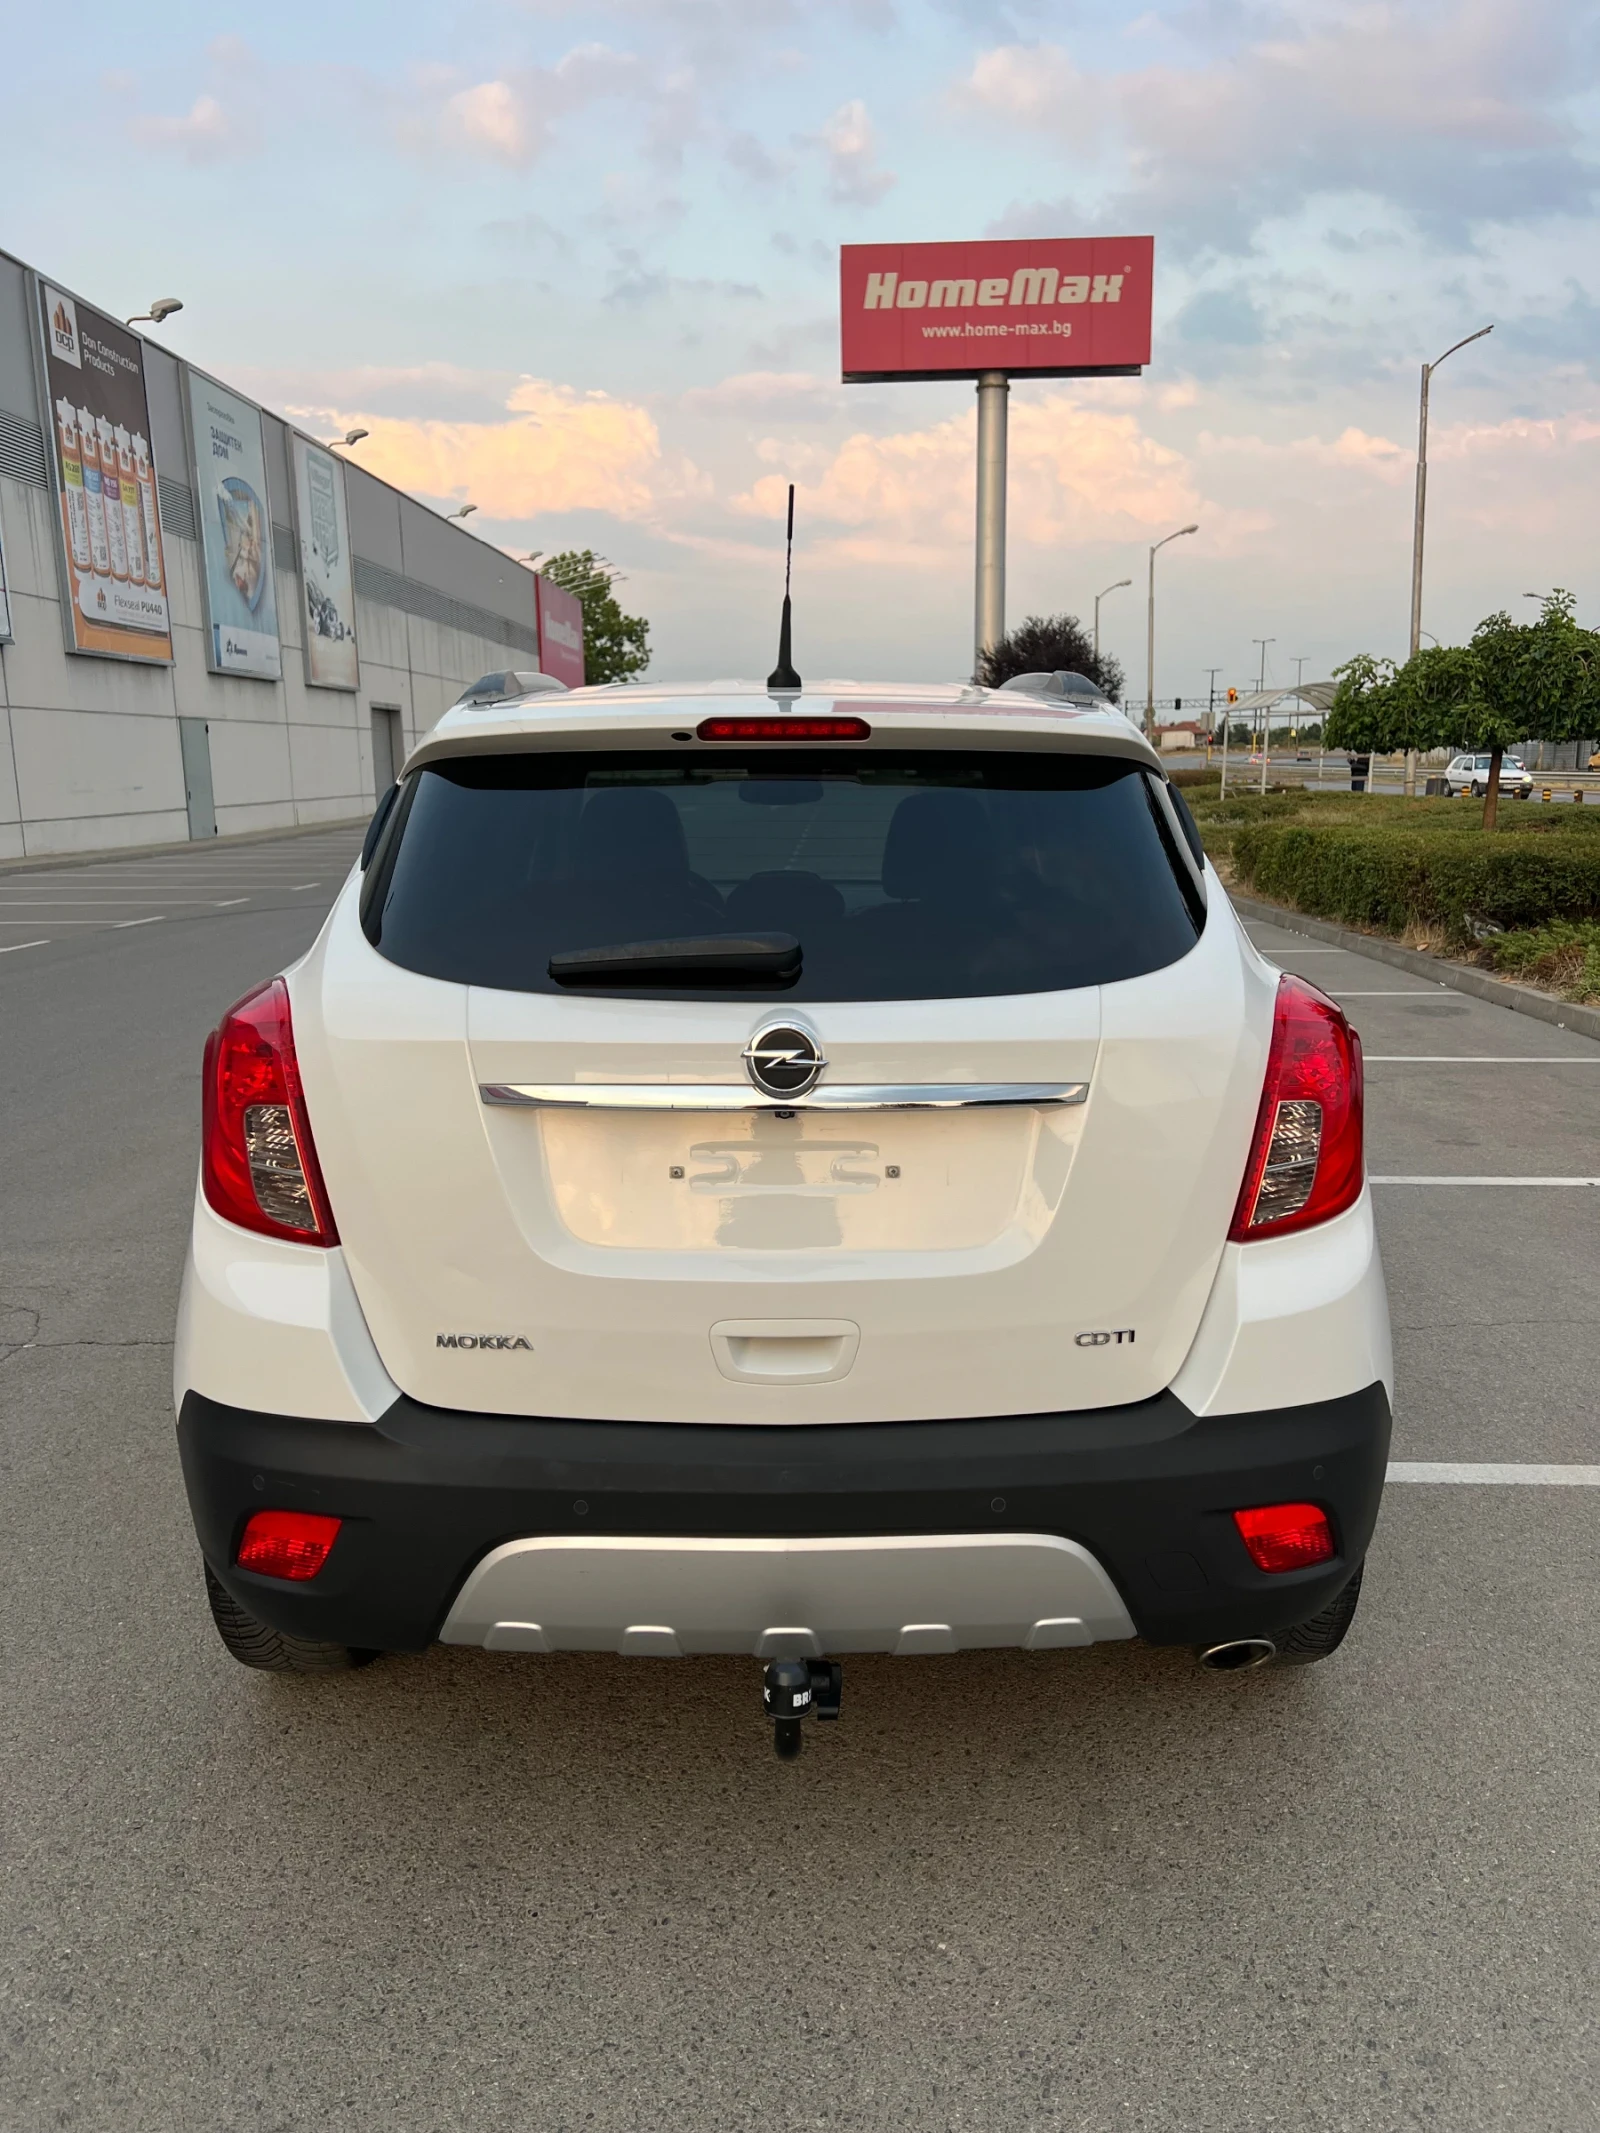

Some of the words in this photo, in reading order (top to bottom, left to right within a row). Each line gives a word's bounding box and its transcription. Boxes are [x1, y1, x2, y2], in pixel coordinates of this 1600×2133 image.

[863, 267, 1125, 310] HomeMax
[921, 320, 1072, 338] www.home-max.bg
[81, 331, 97, 351] Don
[97, 340, 139, 374] Construction
[83, 348, 115, 376] Products
[114, 594, 140, 611] Flexseal
[140, 601, 163, 615] PU440
[436, 1332, 534, 1351] MOKKA
[1074, 1328, 1136, 1347] CDTI
